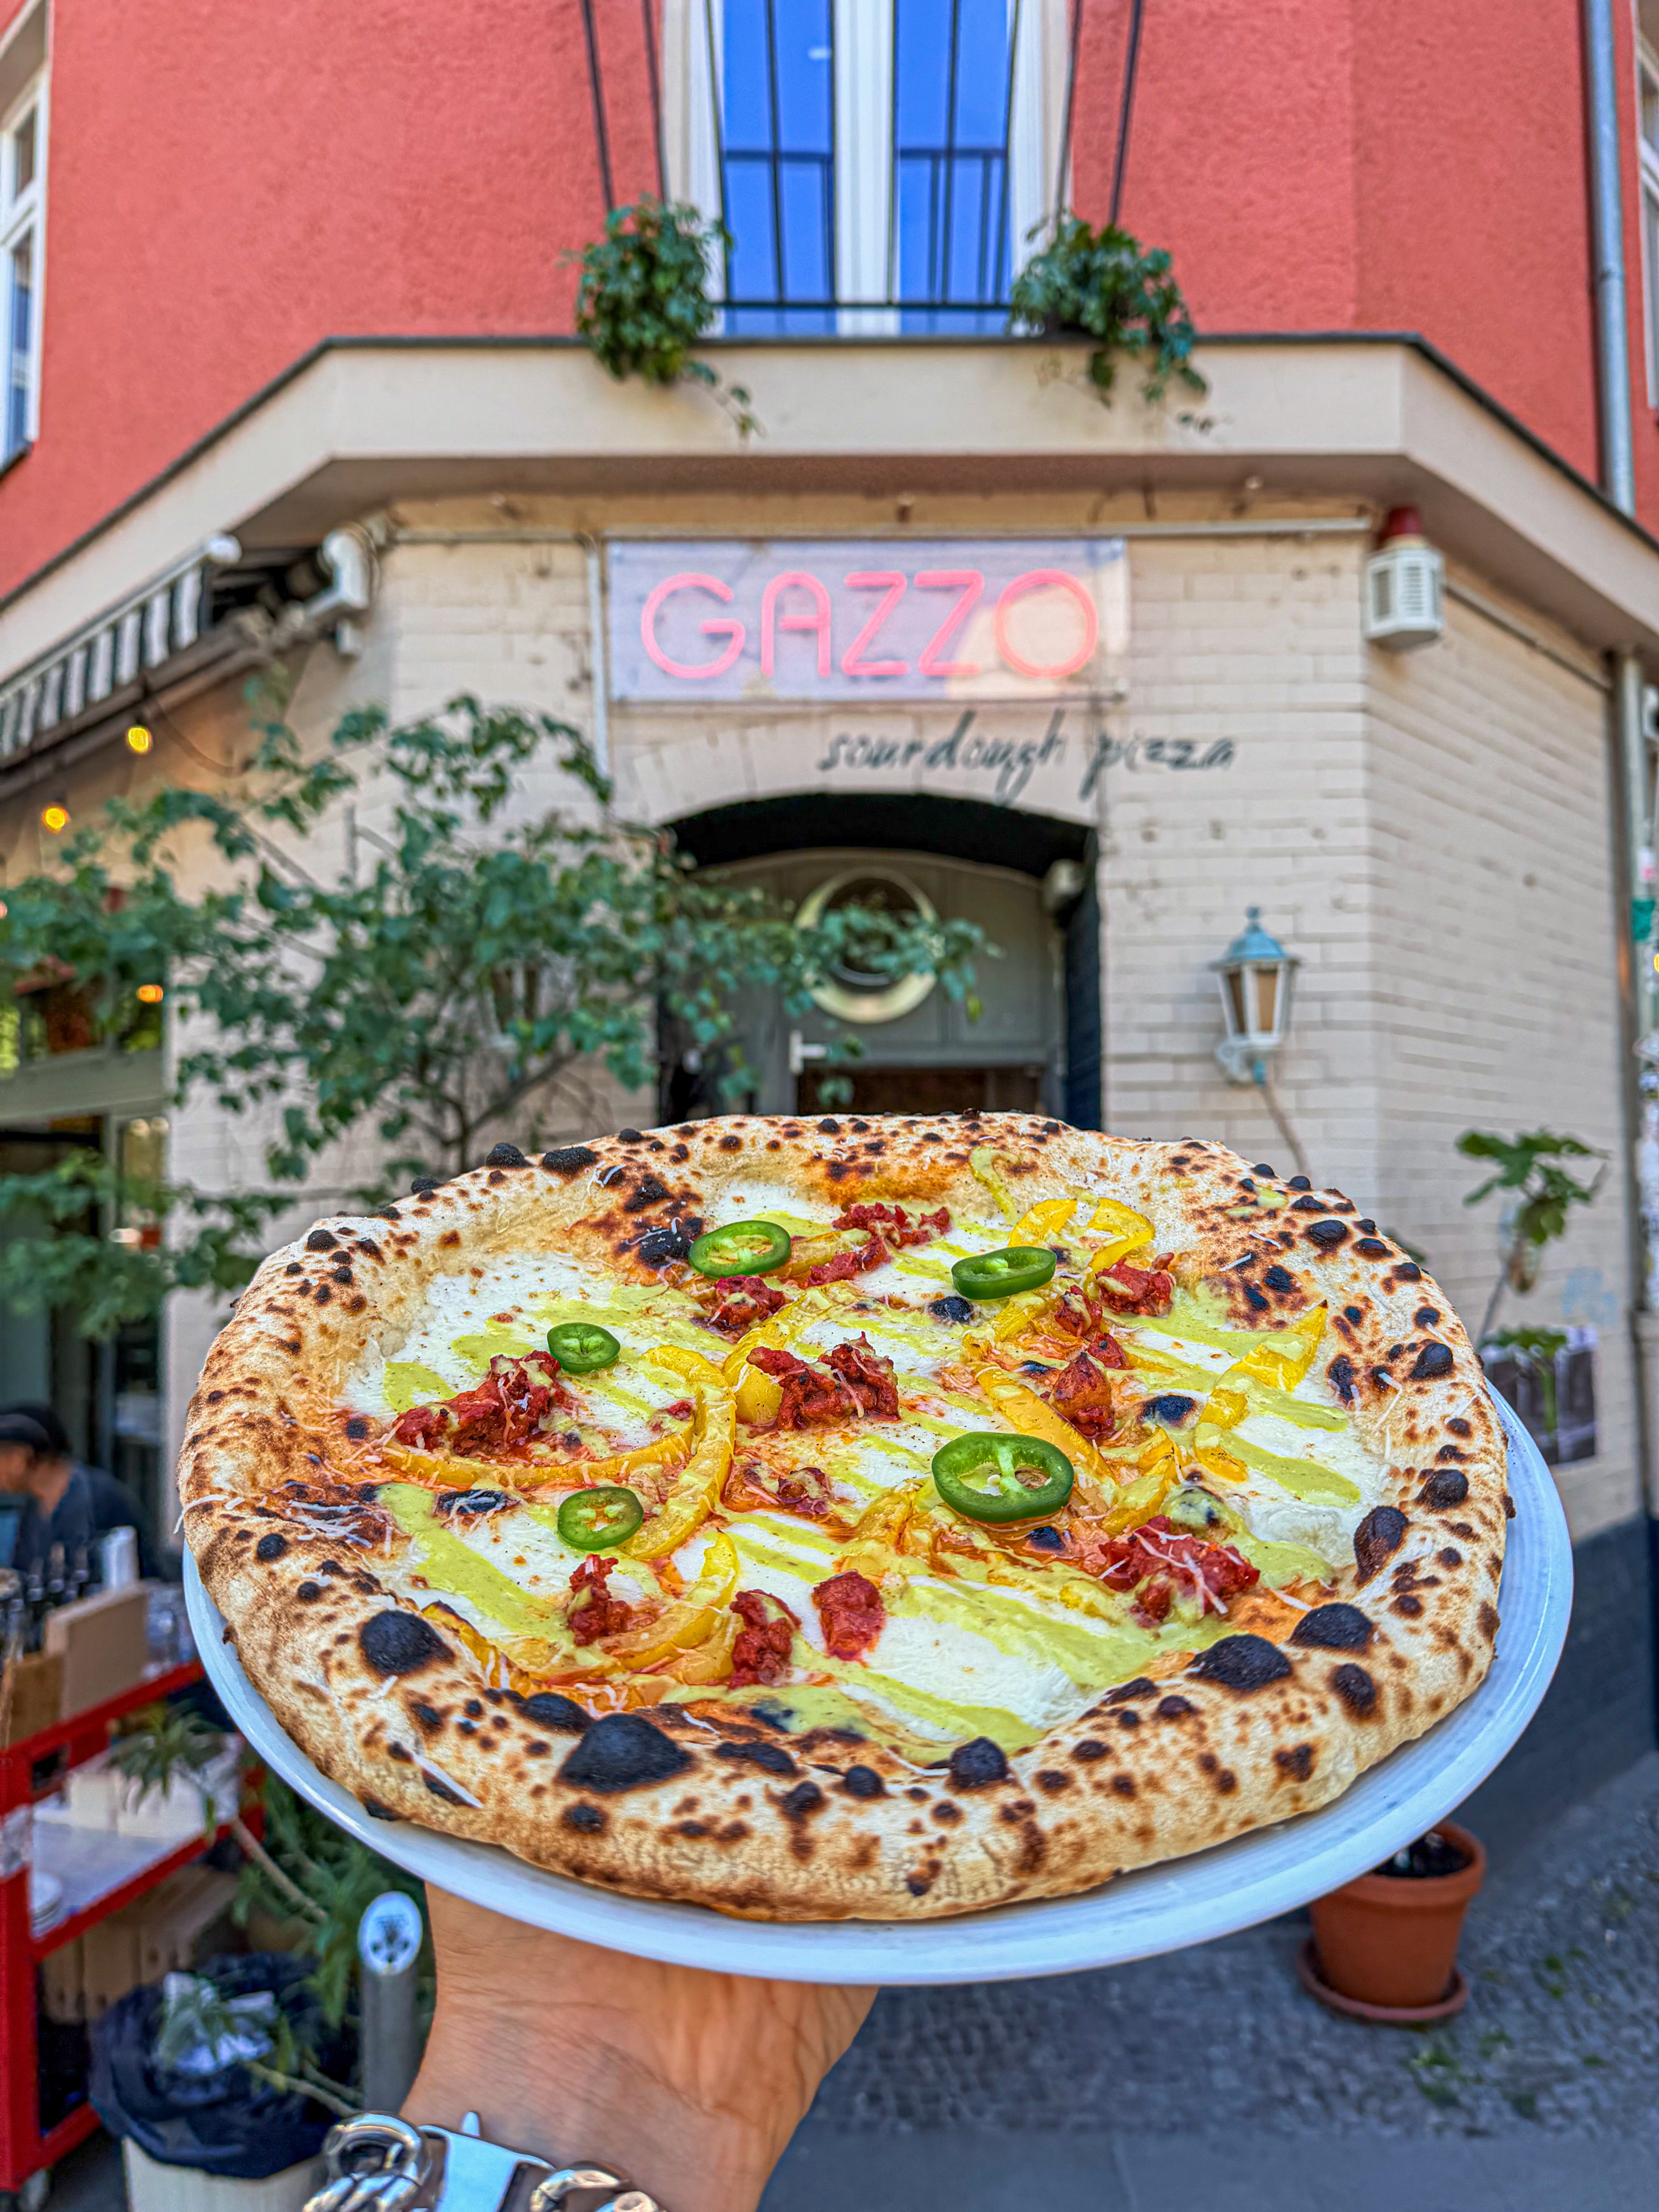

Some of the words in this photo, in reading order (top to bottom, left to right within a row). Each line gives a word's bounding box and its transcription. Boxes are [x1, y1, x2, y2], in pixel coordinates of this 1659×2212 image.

[642, 569, 1098, 679] GAZZO
[818, 708, 1066, 806] sourdough
[1079, 729, 1236, 800] pizza
